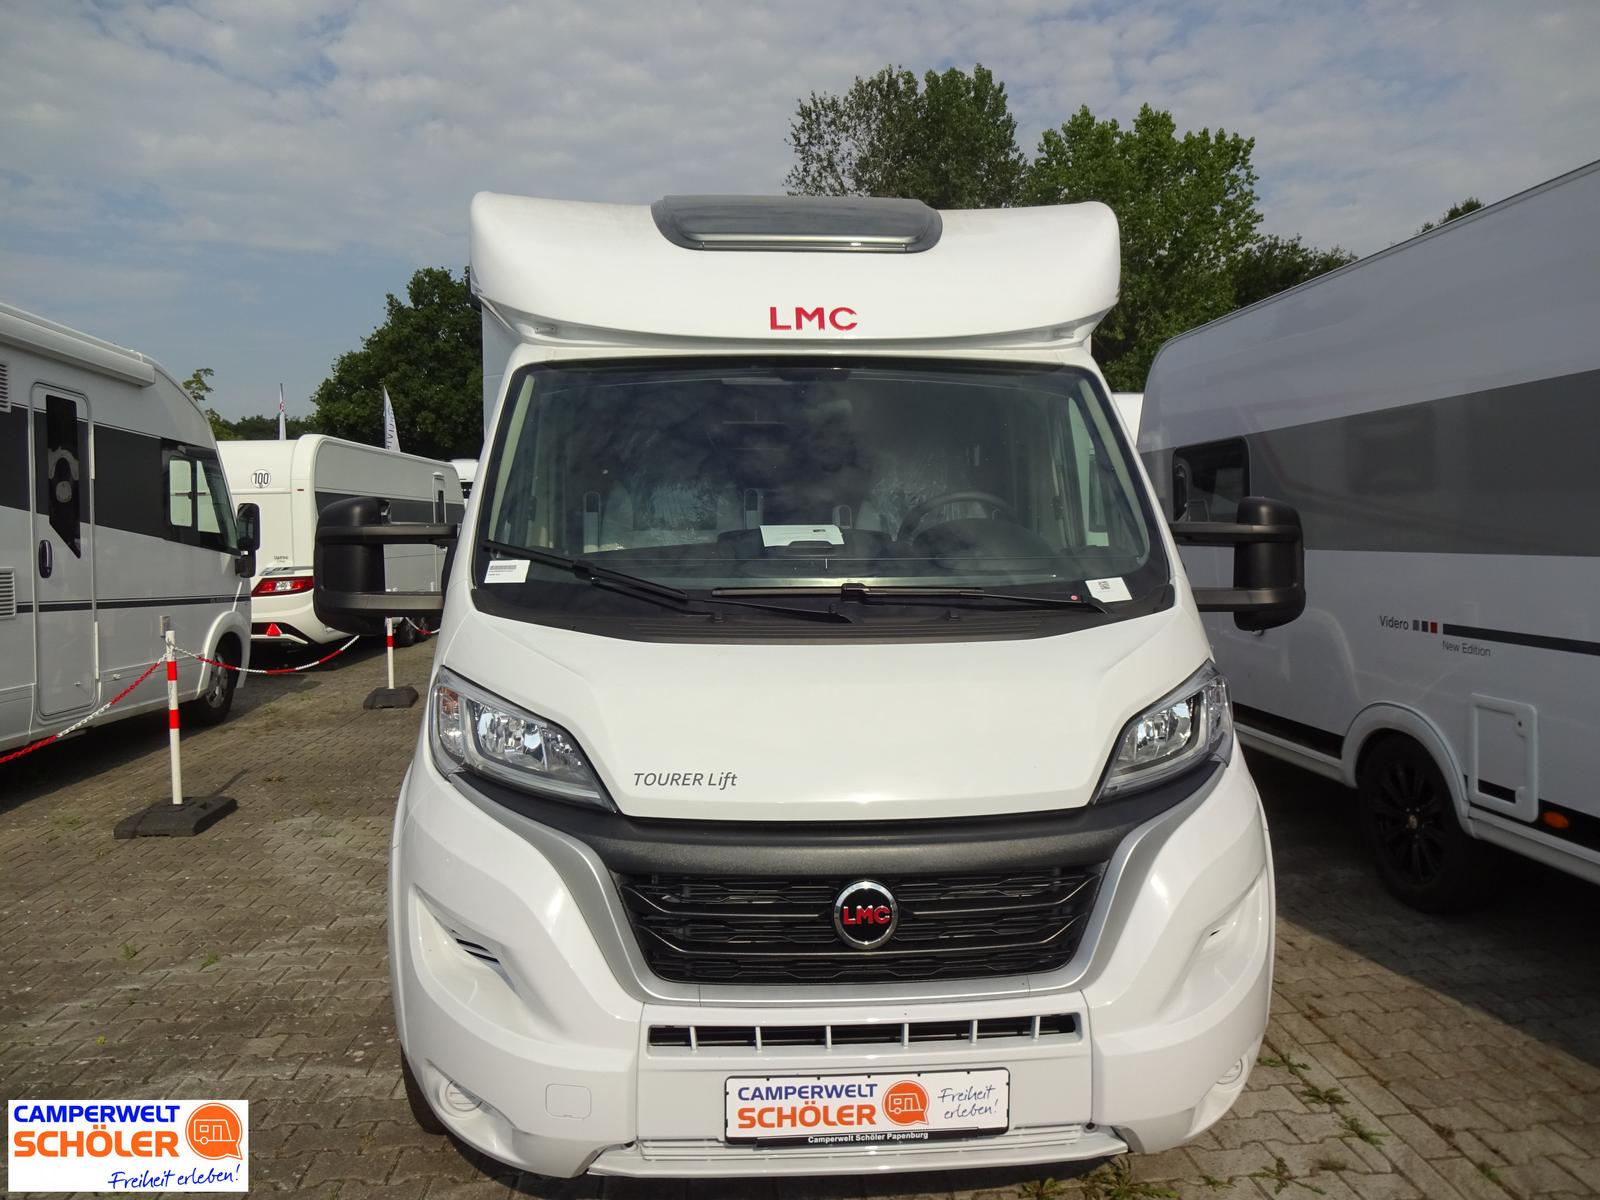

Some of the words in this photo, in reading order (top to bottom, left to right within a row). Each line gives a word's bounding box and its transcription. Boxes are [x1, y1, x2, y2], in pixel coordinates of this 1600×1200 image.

[769, 306, 858, 331] LMC
[253, 472, 270, 485] 100
[1379, 615, 1409, 631] Videro
[1442, 640, 1460, 652] New
[1462, 642, 1492, 657] Edition
[634, 772, 704, 787] TOURER
[707, 771, 738, 791] Lift
[842, 904, 891, 925] LMC
[737, 1083, 878, 1101] CAMPERWELT
[937, 1084, 996, 1103] Freiheit
[737, 1100, 877, 1129] SCHÖLER
[943, 1098, 999, 1120] erleben!
[807, 1135, 854, 1144] Camperwelt
[855, 1133, 886, 1142] Schöler
[886, 1131, 929, 1141] Papenburg
